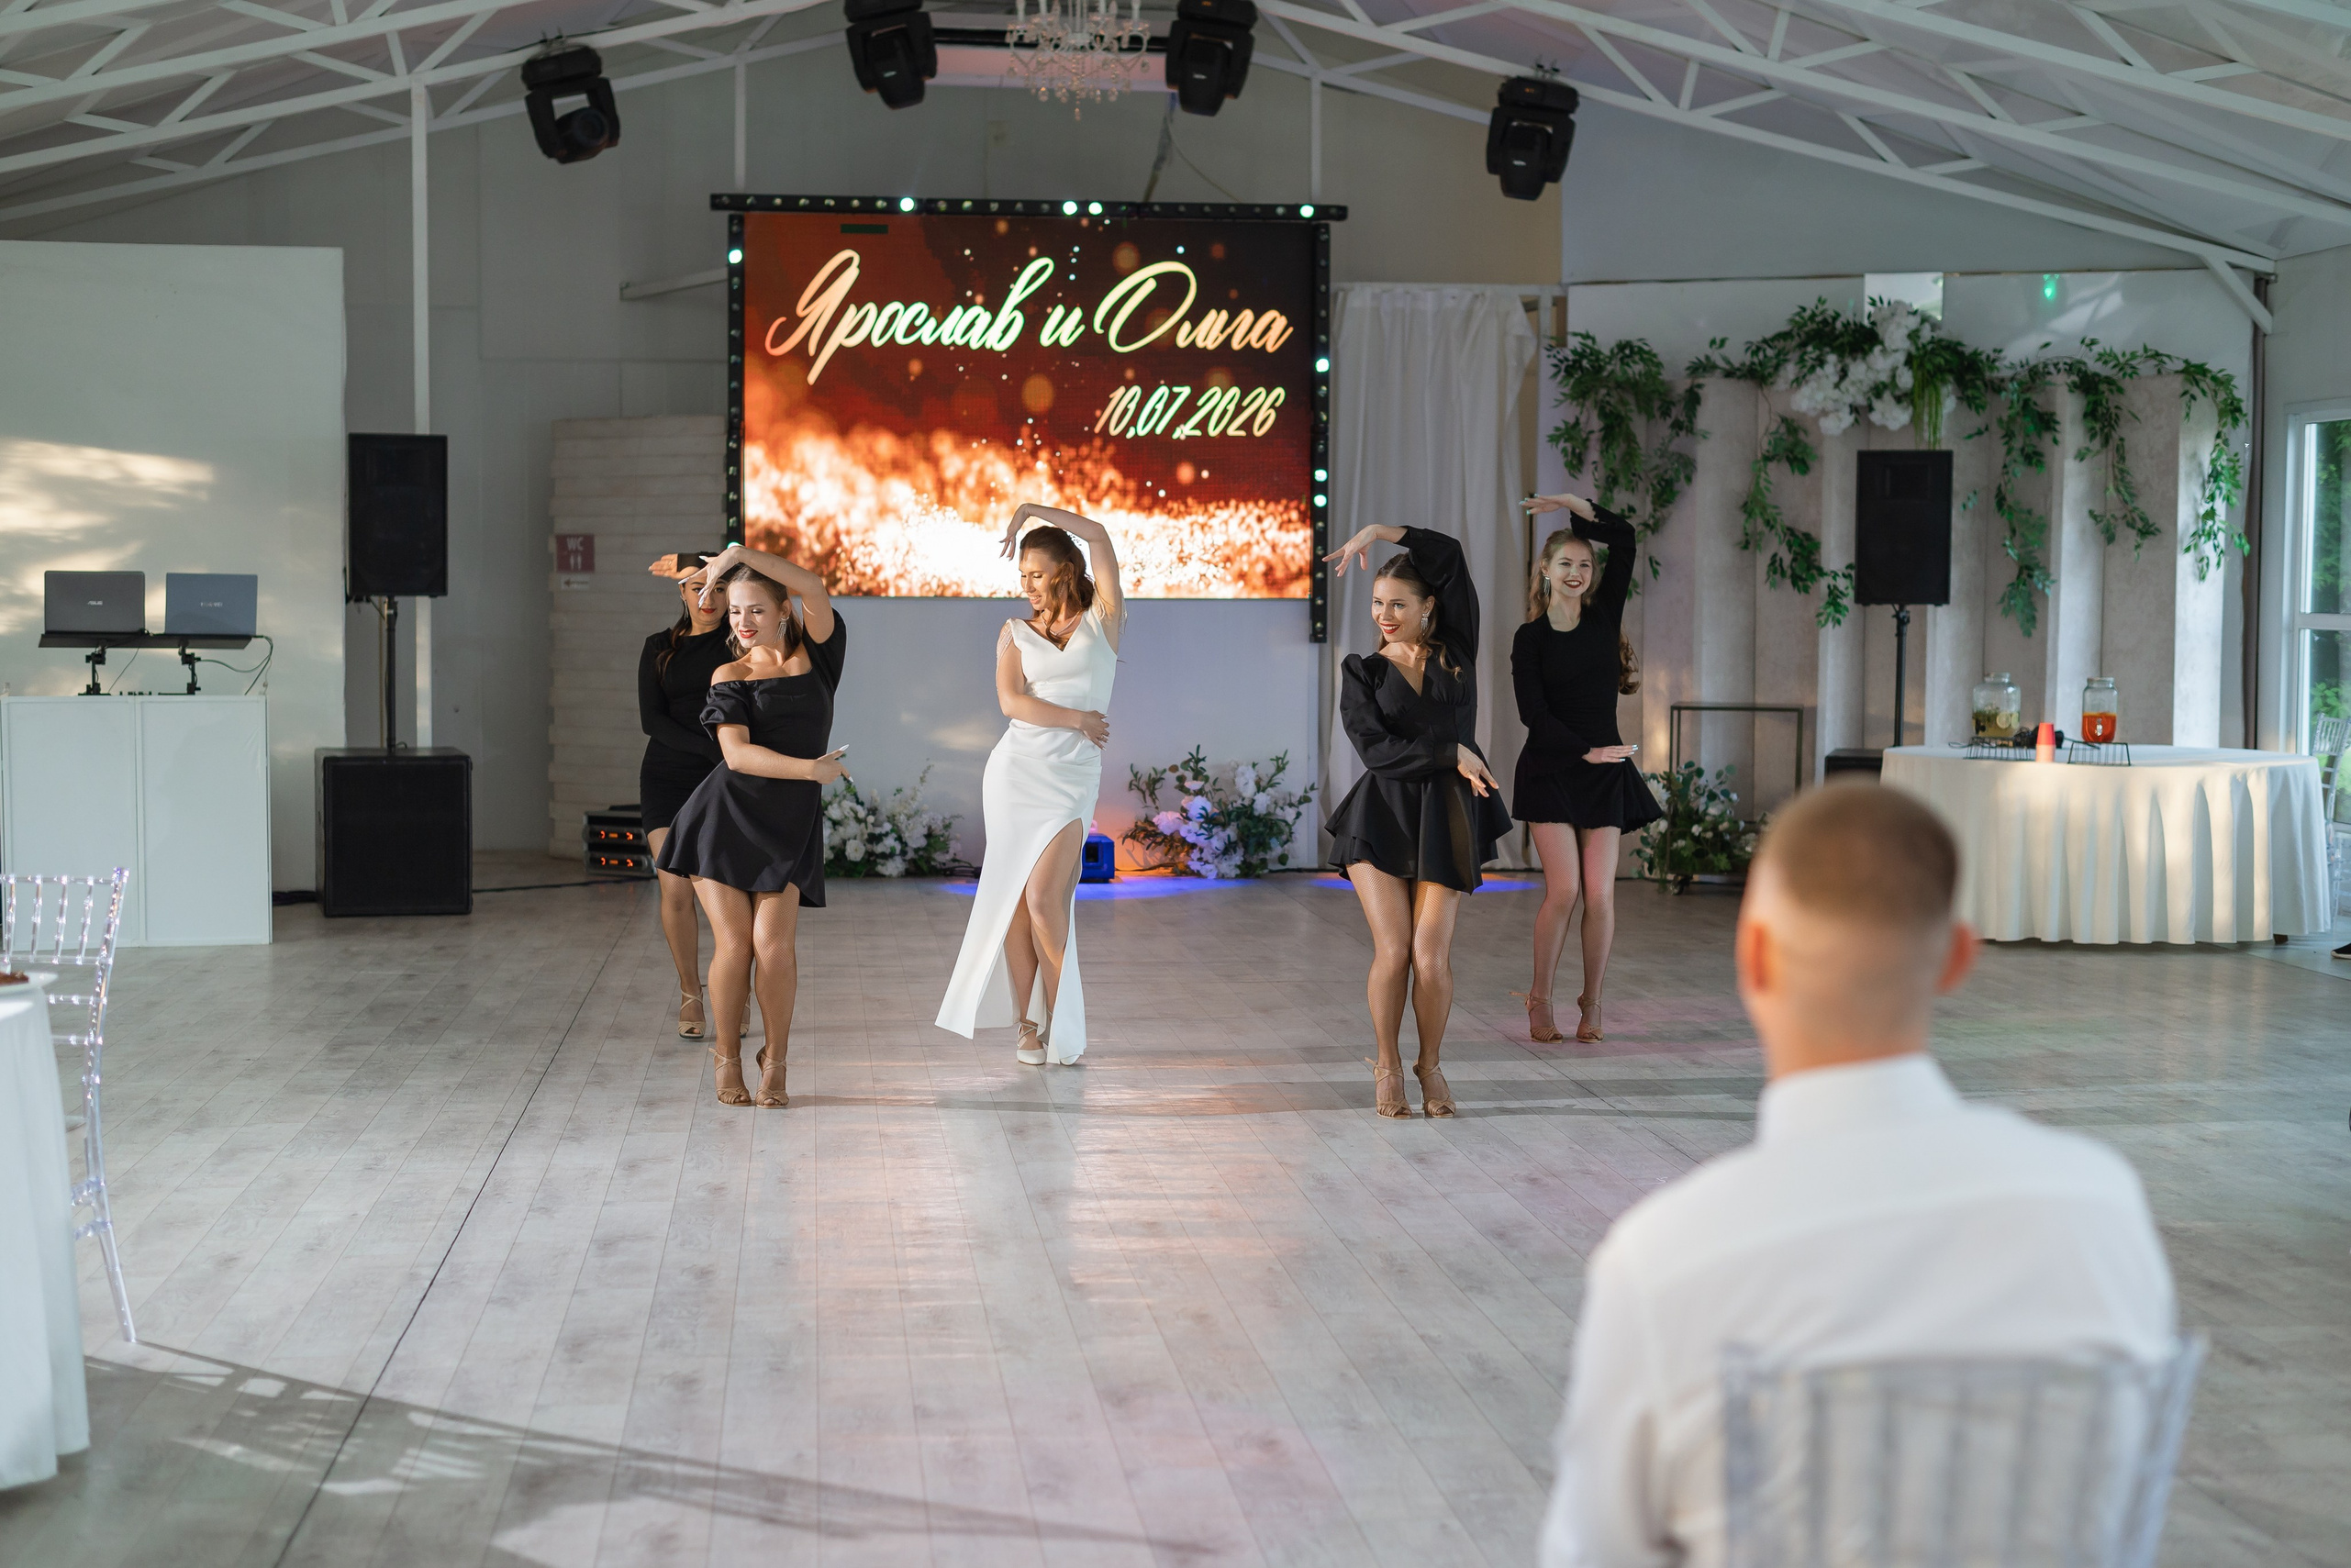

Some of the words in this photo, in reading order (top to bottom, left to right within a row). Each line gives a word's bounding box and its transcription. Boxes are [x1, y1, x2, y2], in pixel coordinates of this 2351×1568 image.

[764, 249, 1054, 385] Ярослав
[1039, 304, 1086, 348] и
[566, 537, 584, 550] WC
